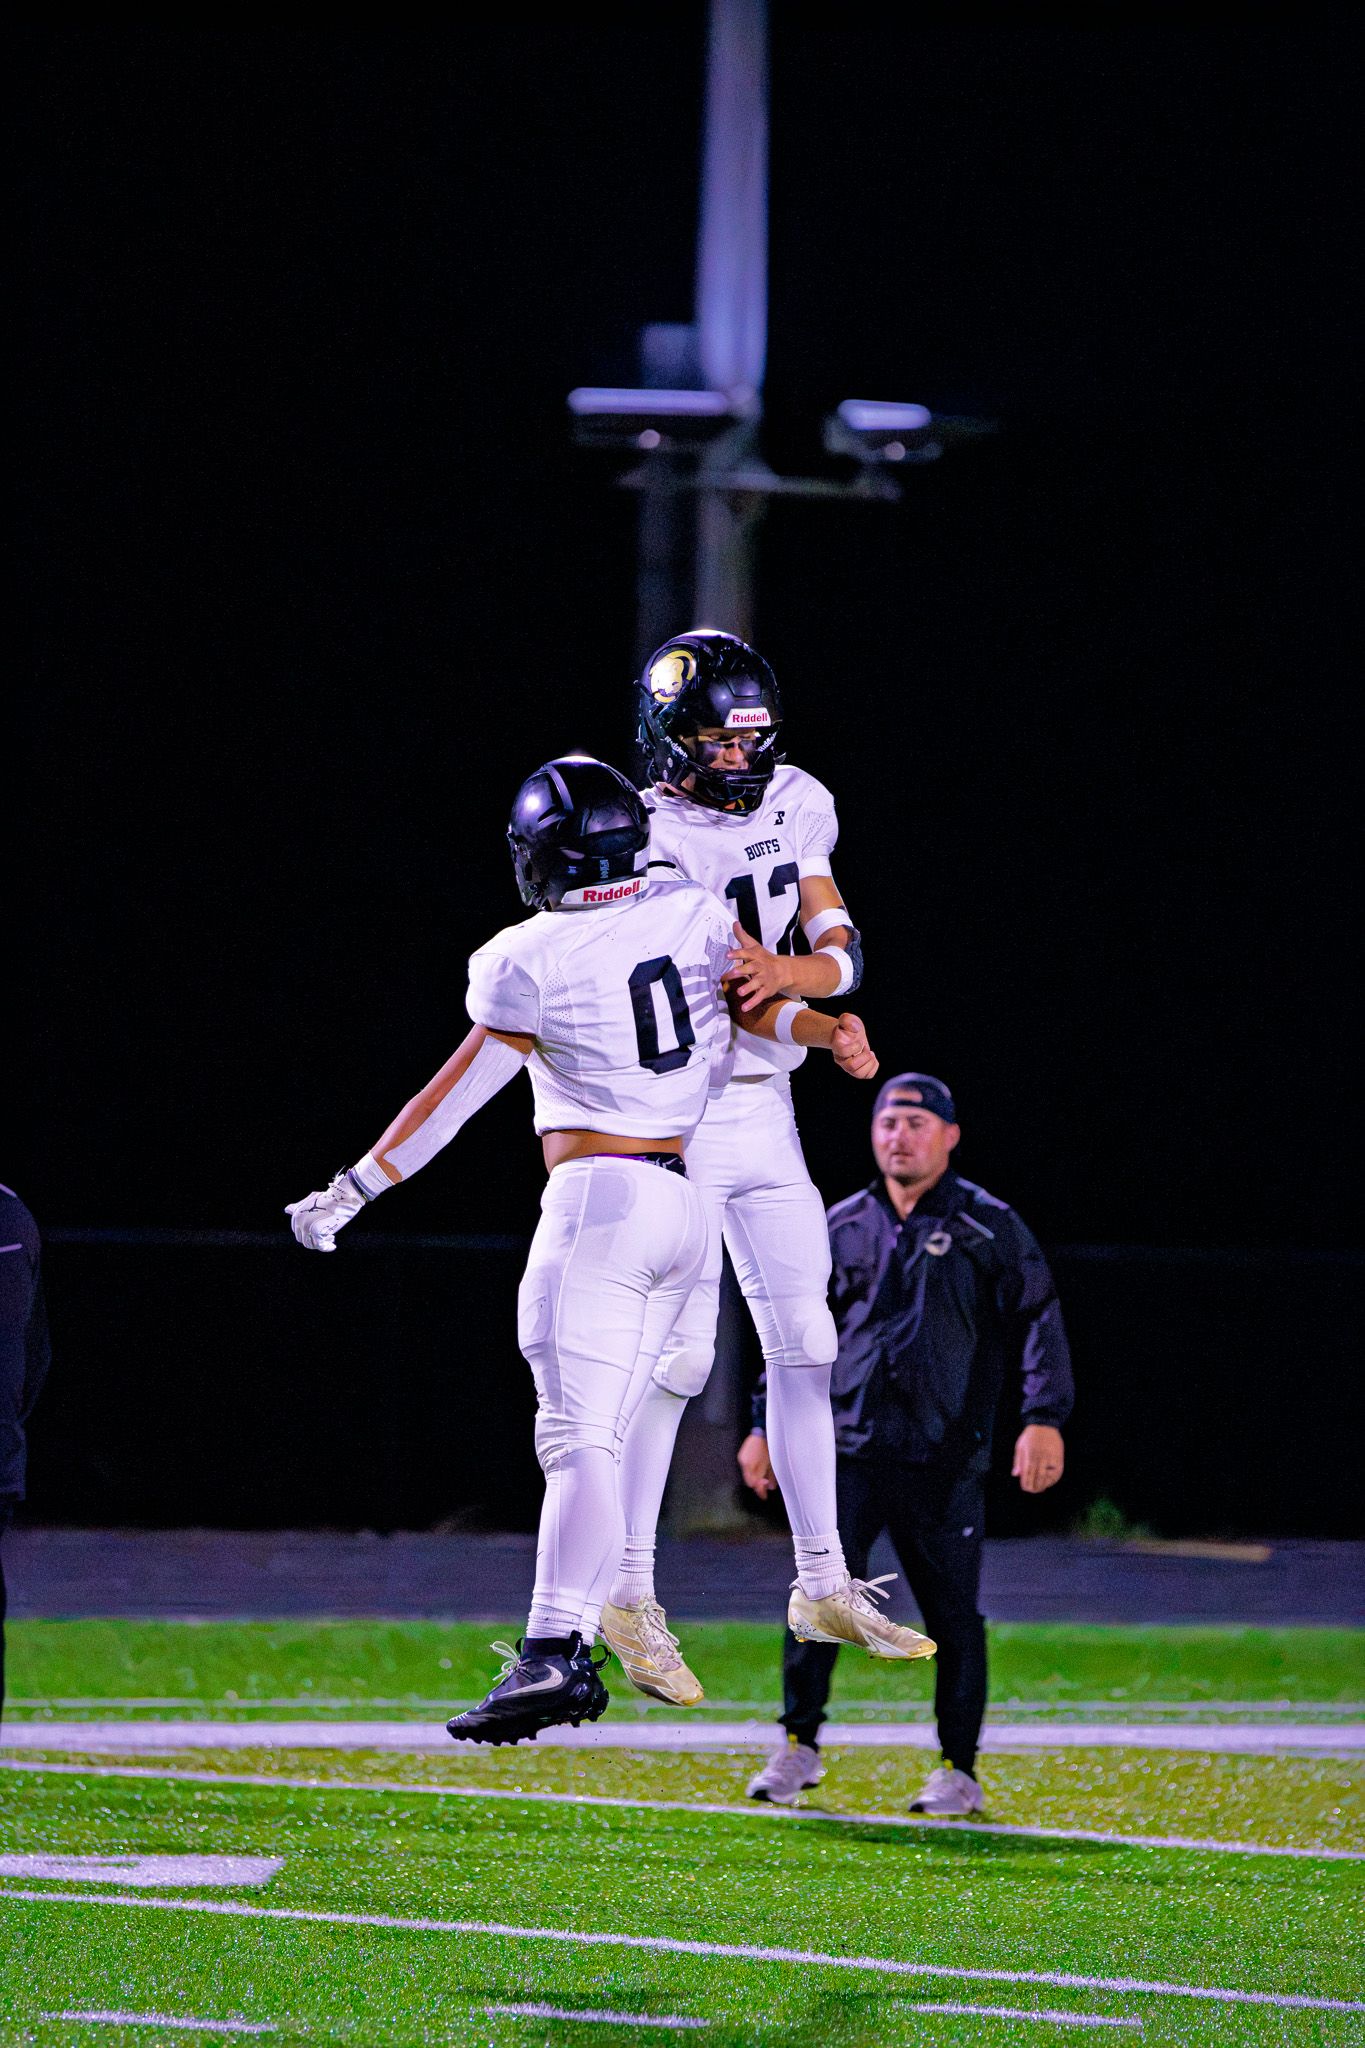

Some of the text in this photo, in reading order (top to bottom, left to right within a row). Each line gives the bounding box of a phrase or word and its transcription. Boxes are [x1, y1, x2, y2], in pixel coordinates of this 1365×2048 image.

[732, 712, 768, 724] Riddell
[744, 838, 781, 861] BUFFS
[582, 879, 641, 902] Riddell
[628, 954, 696, 1075] 0
